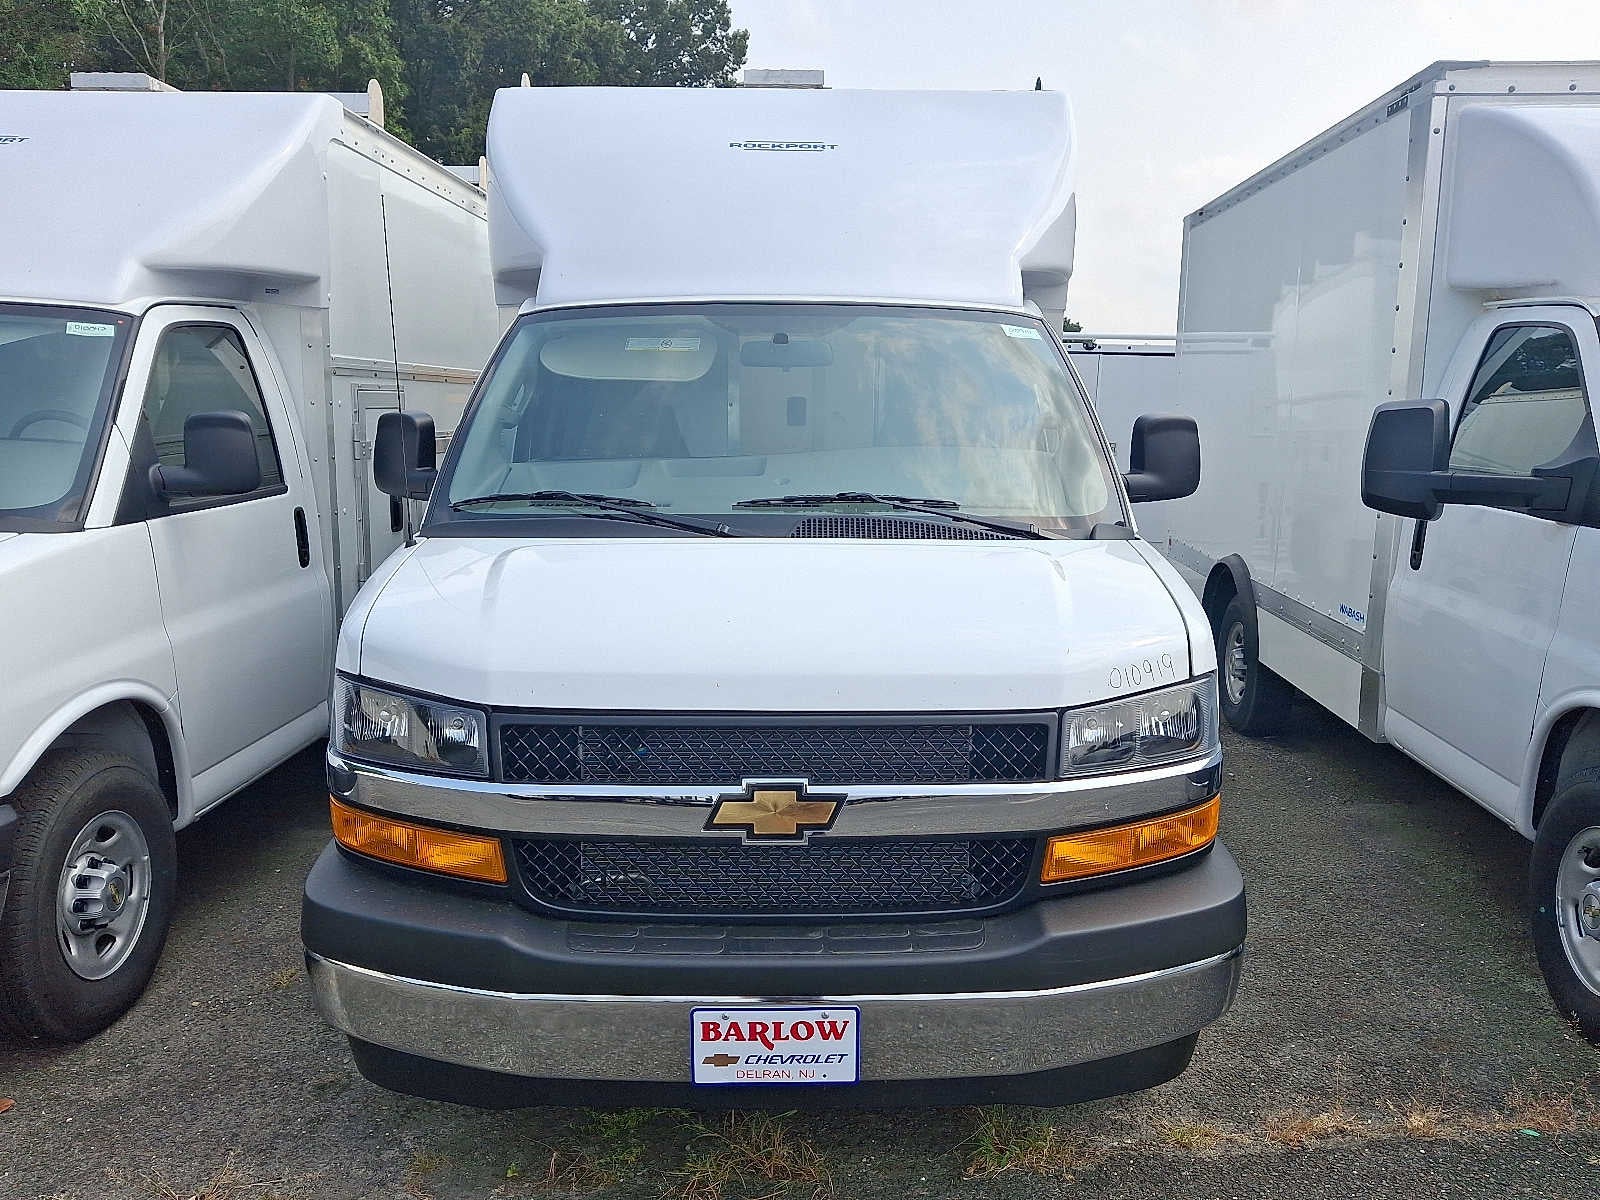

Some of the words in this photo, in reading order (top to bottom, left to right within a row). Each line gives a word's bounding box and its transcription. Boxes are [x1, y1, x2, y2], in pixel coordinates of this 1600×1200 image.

[729, 142, 839, 150] ROCKPORT
[1339, 602, 1365, 623] WABASH
[1109, 653, 1175, 688] 010919
[700, 1020, 850, 1051] BARLOW
[744, 1053, 849, 1065] CHEVROLET
[799, 1069, 816, 1079] NJ
